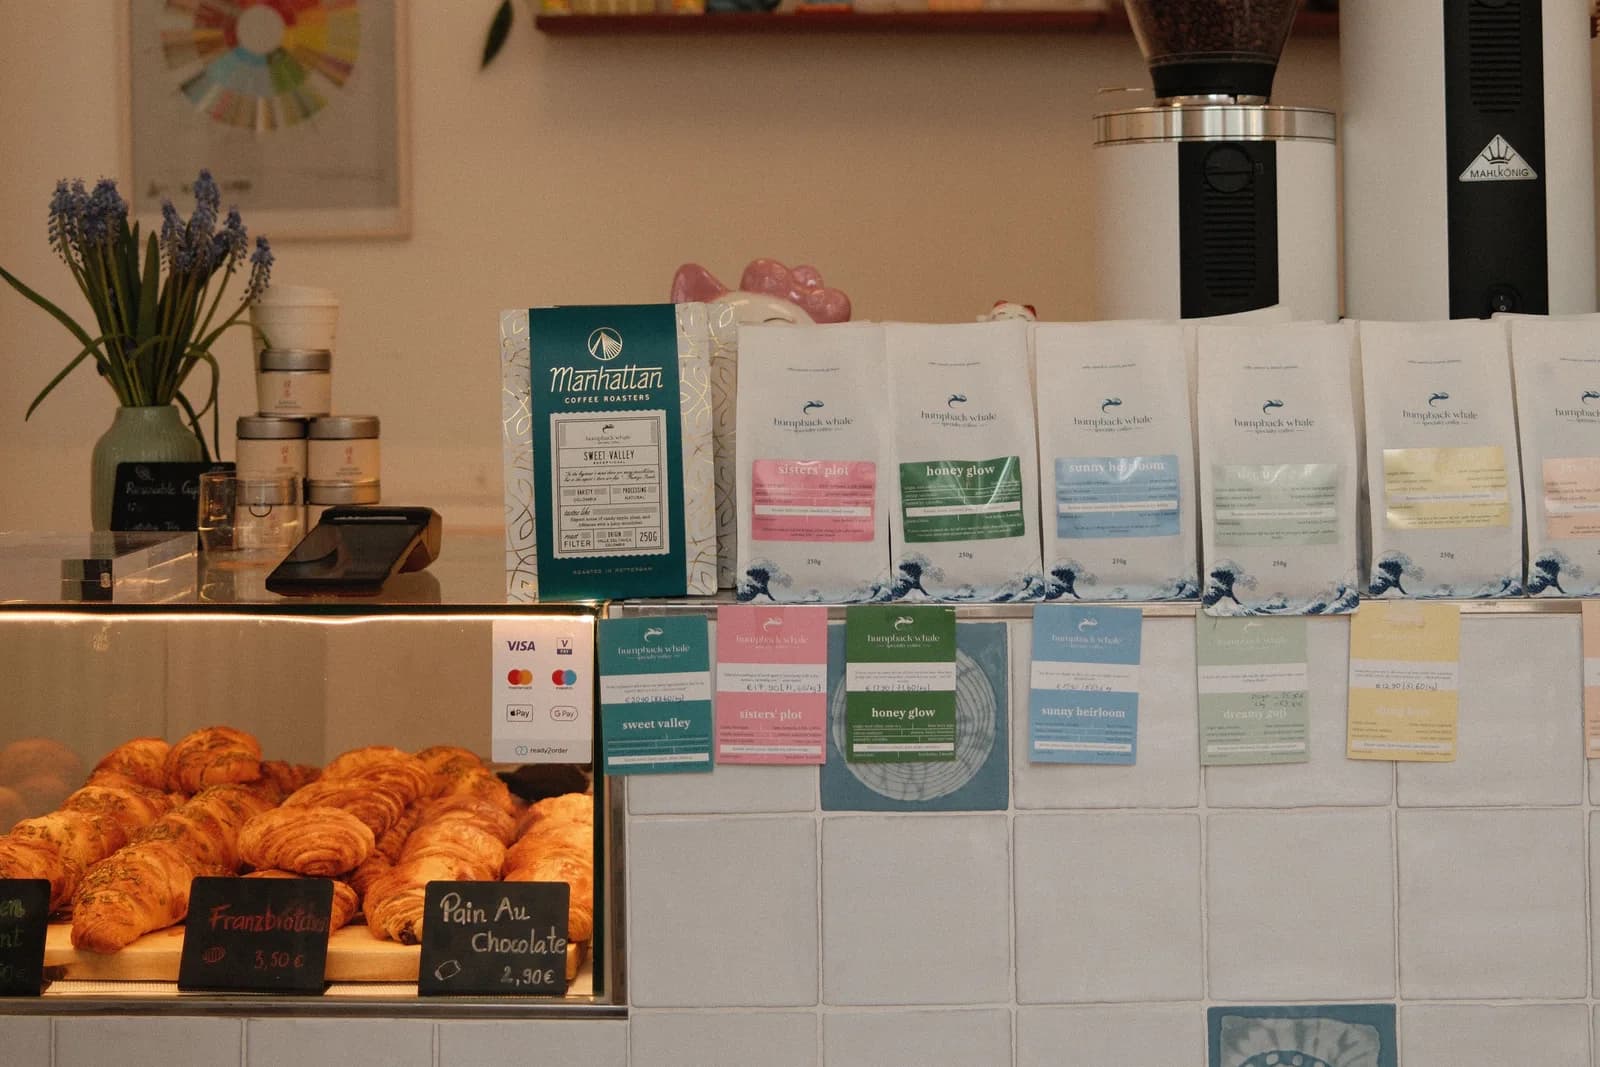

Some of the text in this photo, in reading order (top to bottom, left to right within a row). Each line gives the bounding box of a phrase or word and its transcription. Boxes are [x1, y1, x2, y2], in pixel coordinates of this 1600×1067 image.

[1470, 164, 1529, 177] MAHLKÖNIG
[550, 366, 663, 393] Manhattan
[564, 394, 650, 404] COFFEE ROASTERS
[921, 410, 997, 421] humpback whale
[1402, 409, 1479, 421] humpback whale
[773, 416, 853, 428] humpback whale
[1074, 415, 1153, 428] humpback whale
[1234, 417, 1315, 429] humpback whale
[584, 449, 635, 461] SWEET VALLEY
[824, 463, 849, 477] plot
[926, 464, 995, 478] honey glow
[622, 486, 646, 494] PROCESSING
[640, 531, 658, 543] 250G
[564, 540, 591, 548] FILTER
[561, 639, 569, 648] V
[867, 633, 941, 645] humpback whale
[507, 640, 536, 651] VISA
[617, 643, 691, 656] humpback whale
[516, 709, 530, 719] Pay
[562, 709, 574, 719] Pay
[739, 708, 802, 721] sisters' plot
[871, 707, 936, 720] honey glow
[1041, 705, 1126, 719] sunny heirloom
[622, 717, 691, 731] sweet valley
[440, 892, 530, 925] Pain Au
[471, 926, 566, 955] Chocolate
[500, 966, 555, 987] 2,90€
